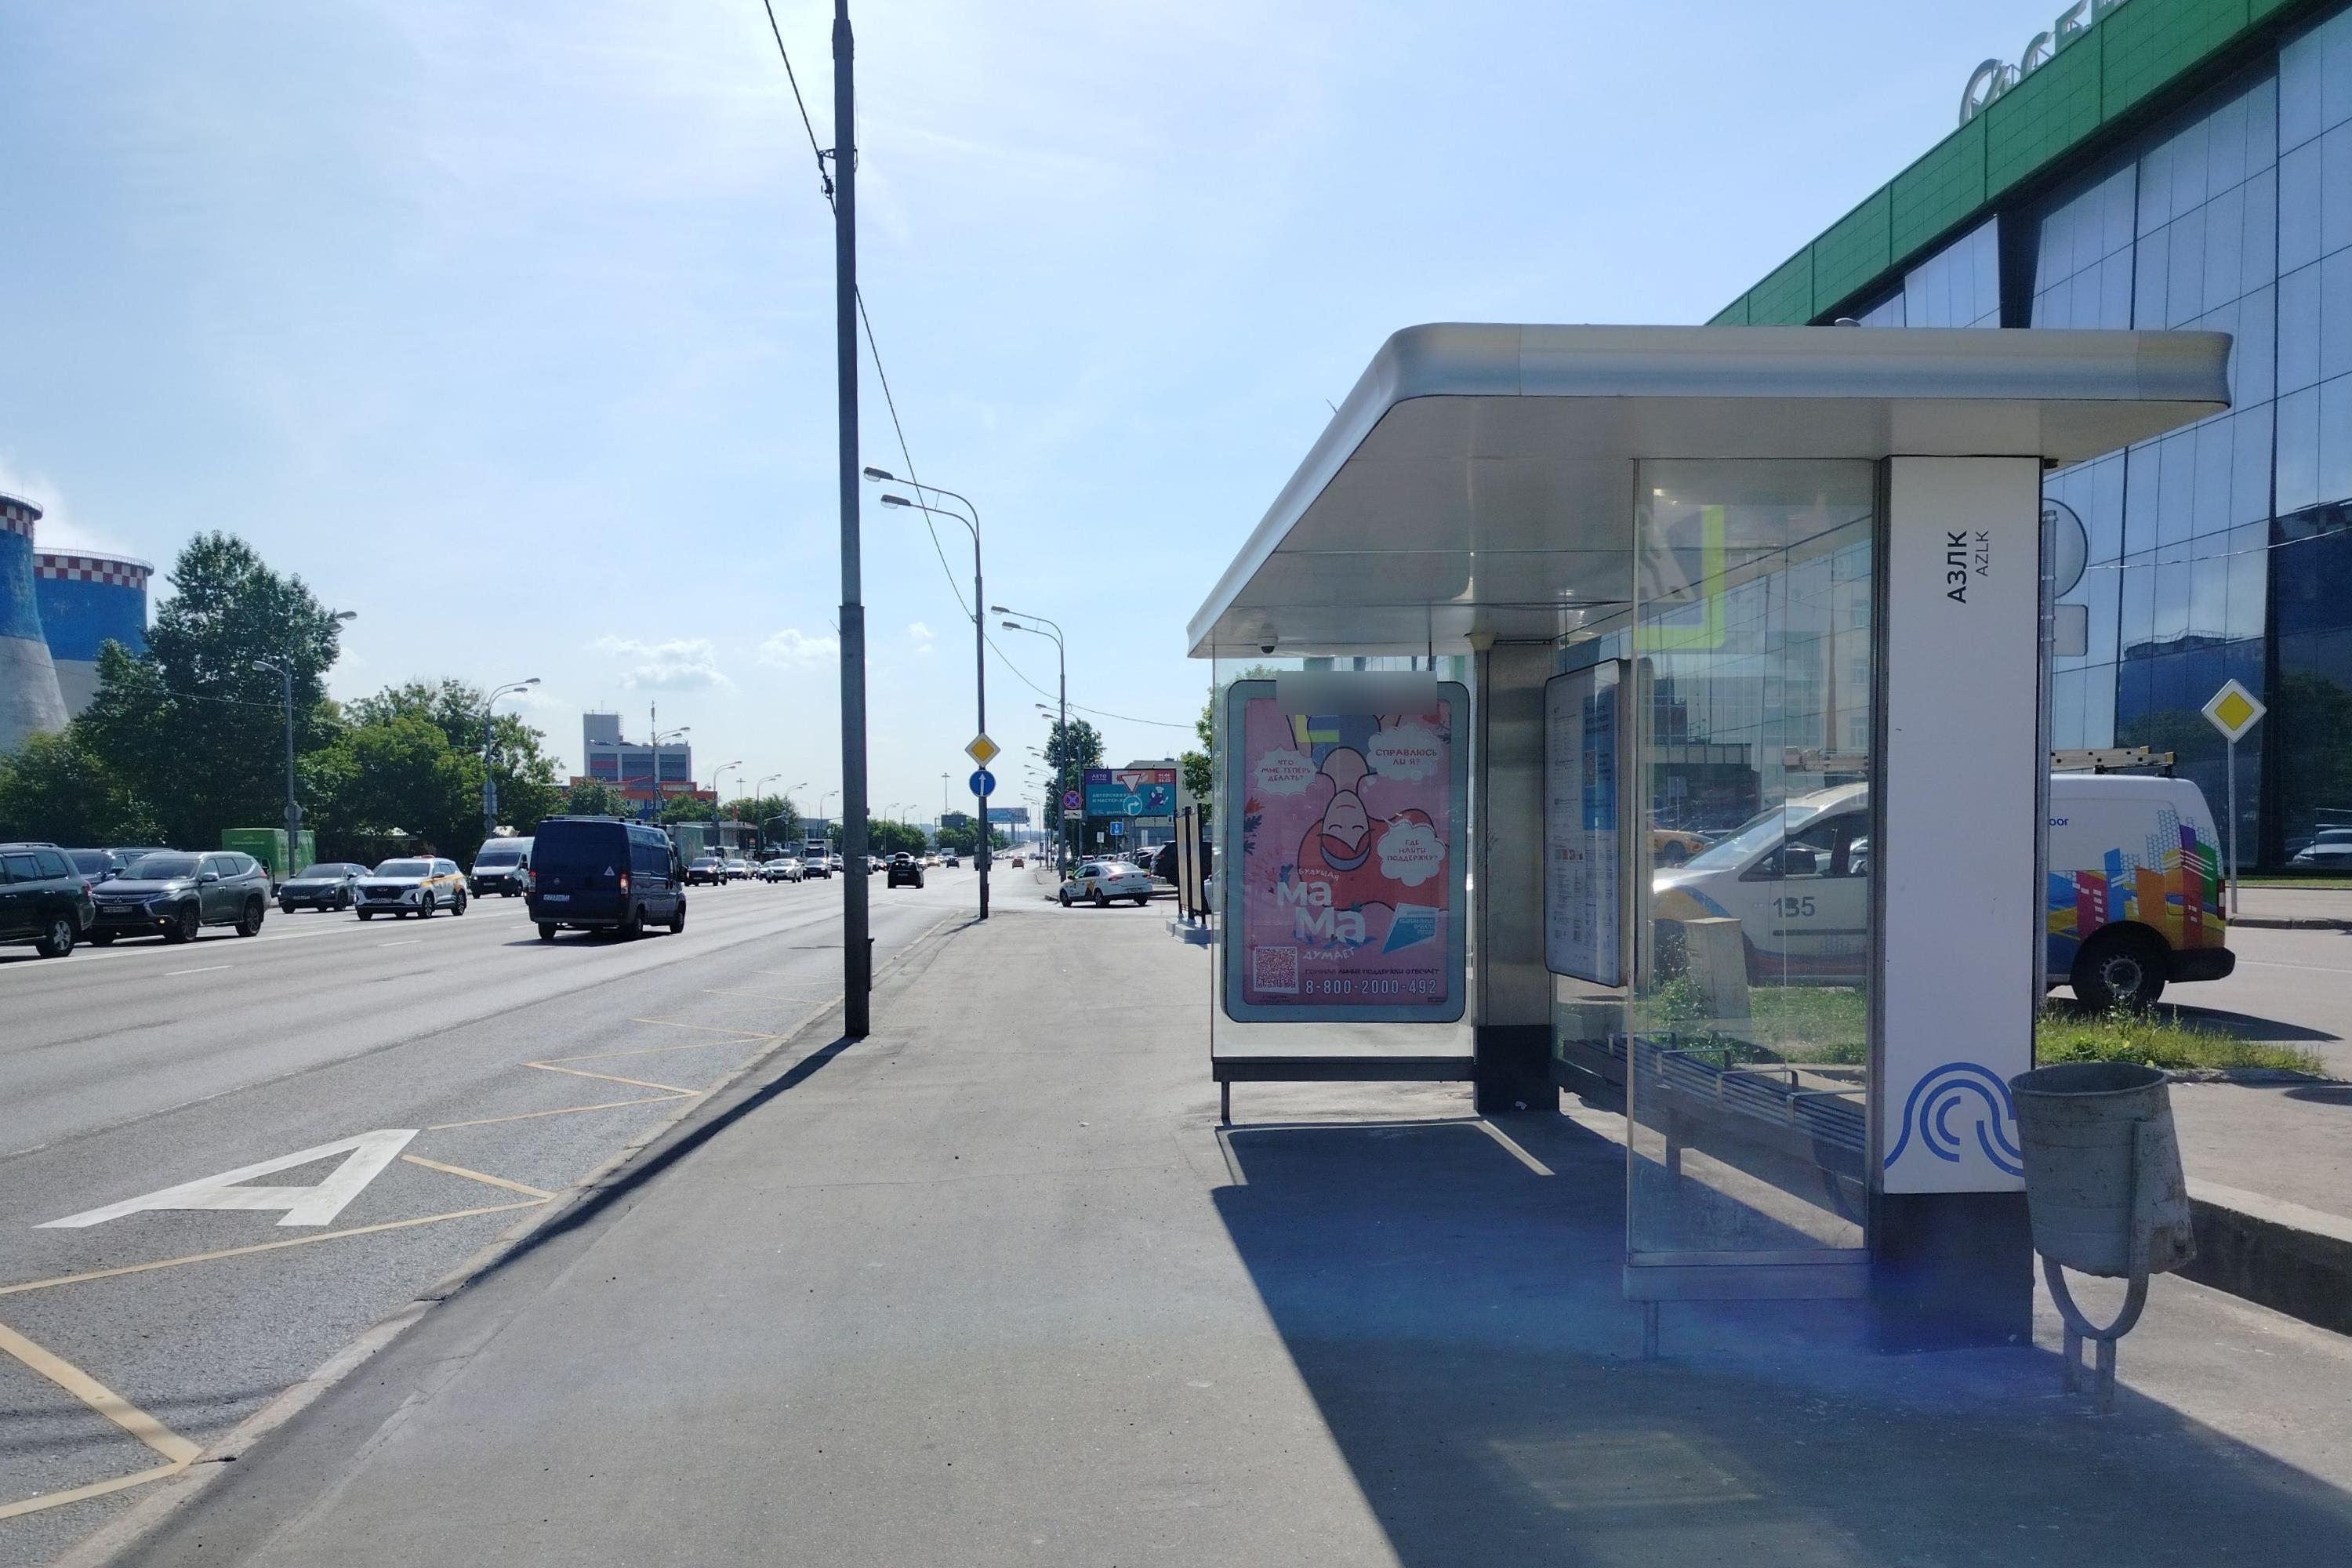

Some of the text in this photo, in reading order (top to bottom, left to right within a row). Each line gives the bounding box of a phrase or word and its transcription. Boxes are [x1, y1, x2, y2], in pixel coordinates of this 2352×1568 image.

[1947, 530, 1967, 604] АЗЛК
[1975, 530, 1989, 577] AZLK
[1302, 947, 1356, 960] ДУМАЕТ
[1305, 979, 1437, 994] 8-800-2000-492
